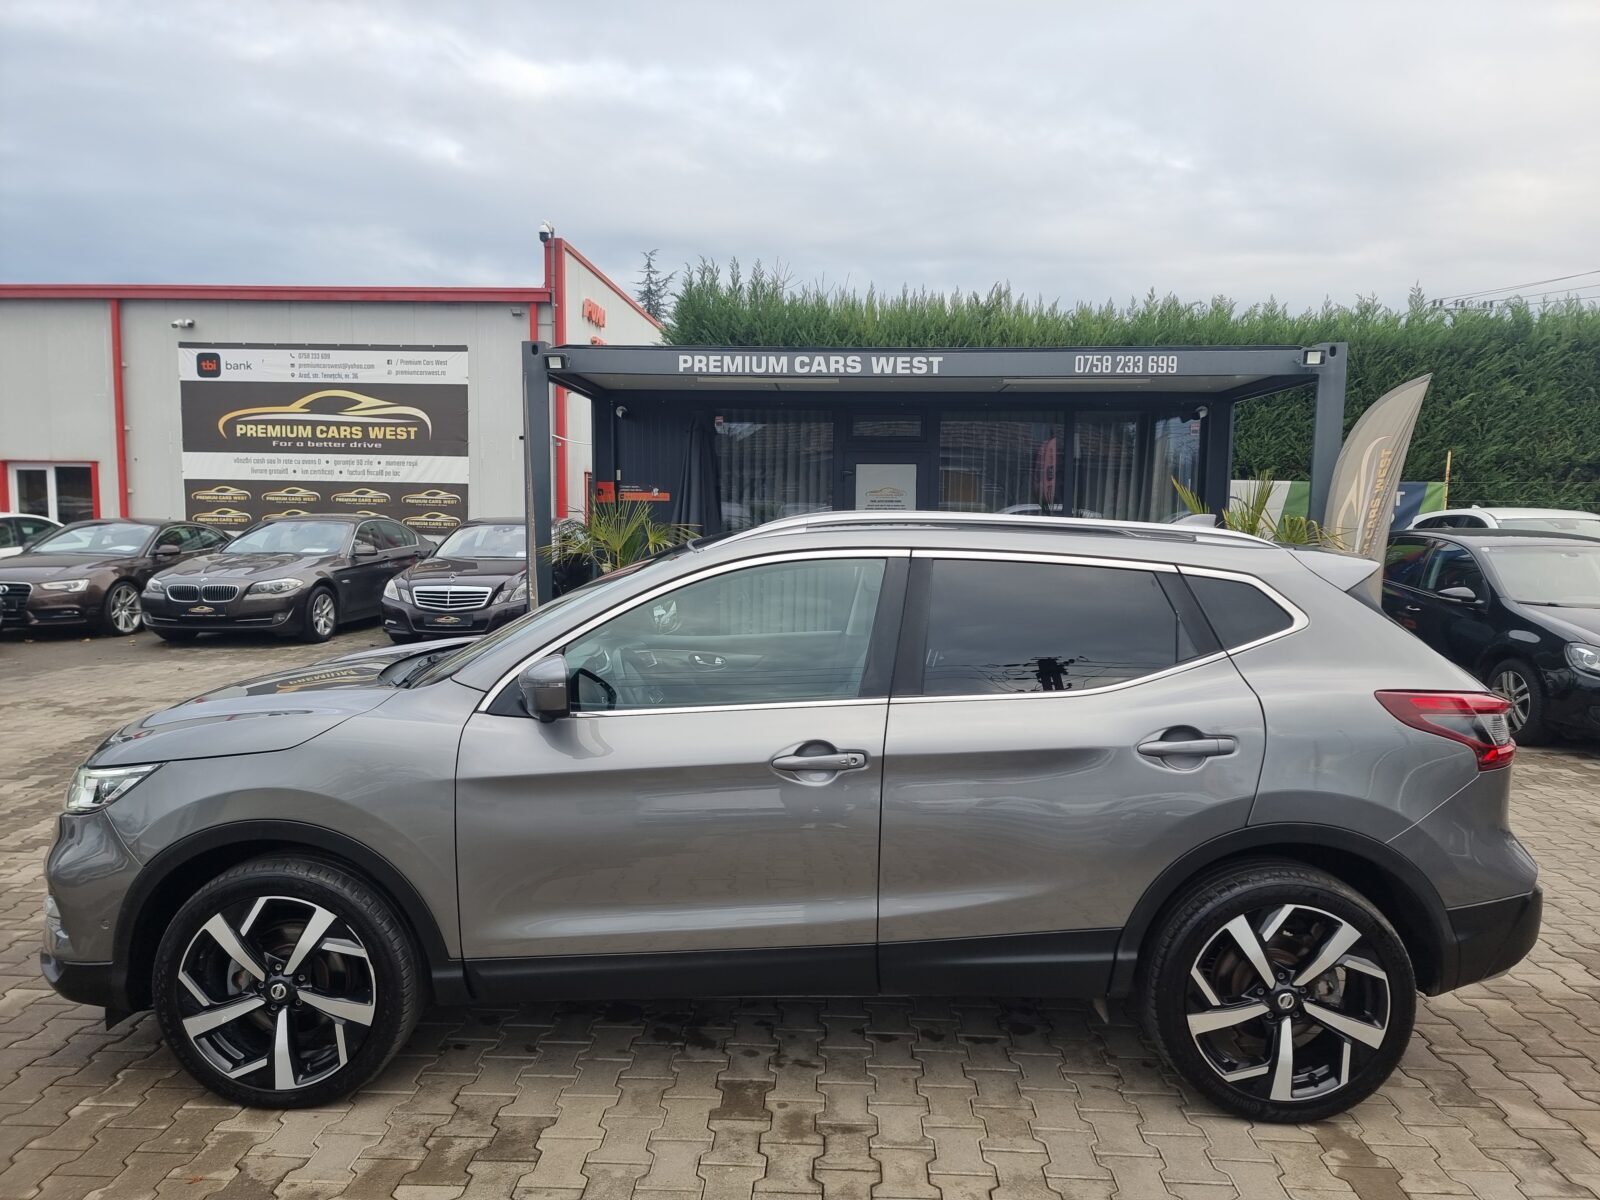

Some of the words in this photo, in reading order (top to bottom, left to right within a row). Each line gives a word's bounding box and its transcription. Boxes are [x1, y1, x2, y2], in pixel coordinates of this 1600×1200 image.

[201, 360, 217, 371] tbi
[225, 360, 252, 371] bank
[678, 354, 788, 373] PREMIUM
[794, 355, 862, 374] CARS
[871, 356, 943, 374] WEST
[1074, 355, 1112, 373] 0758
[1116, 355, 1143, 373] 233
[1148, 355, 1178, 373] 699
[236, 424, 312, 438] PREMIUM
[316, 425, 363, 439] CARS
[368, 426, 418, 440] WEST
[307, 440, 347, 448] better
[349, 440, 382, 448] drive
